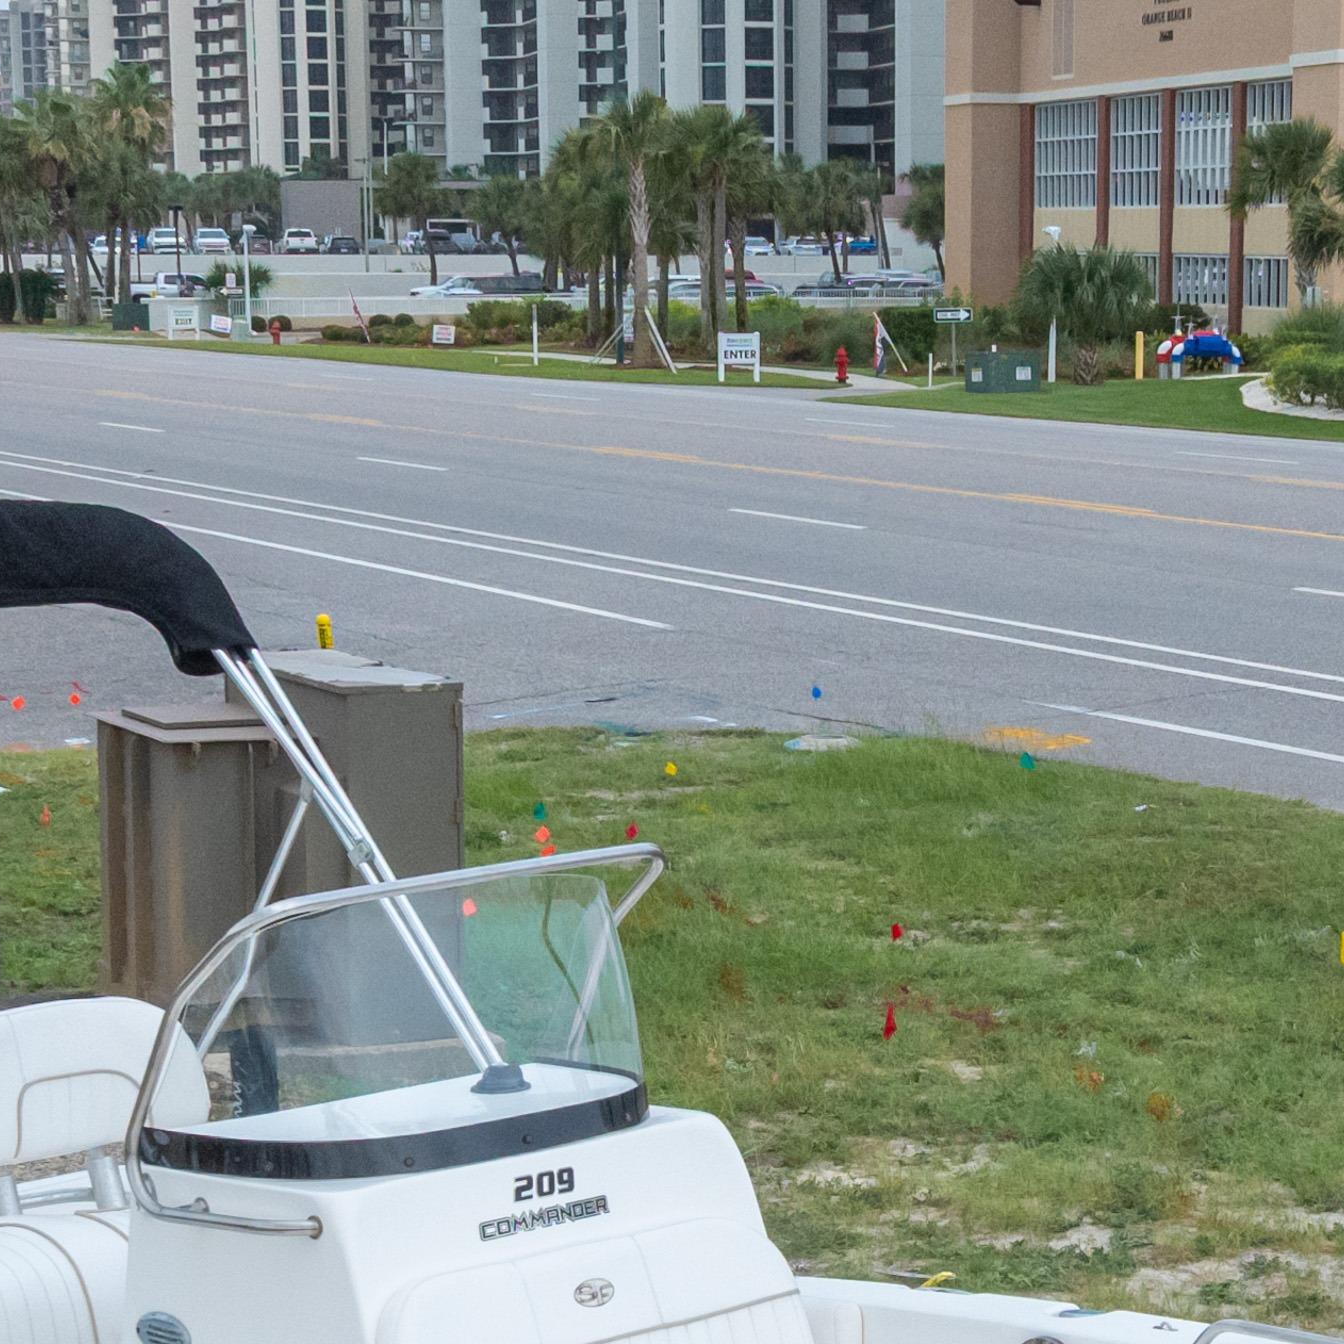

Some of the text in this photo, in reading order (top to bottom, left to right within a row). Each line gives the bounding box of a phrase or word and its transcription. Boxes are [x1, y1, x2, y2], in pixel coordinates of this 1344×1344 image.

[724, 350, 757, 359] ENTER
[513, 1166, 575, 1202] 209
[478, 1194, 611, 1242] COMMANDER
